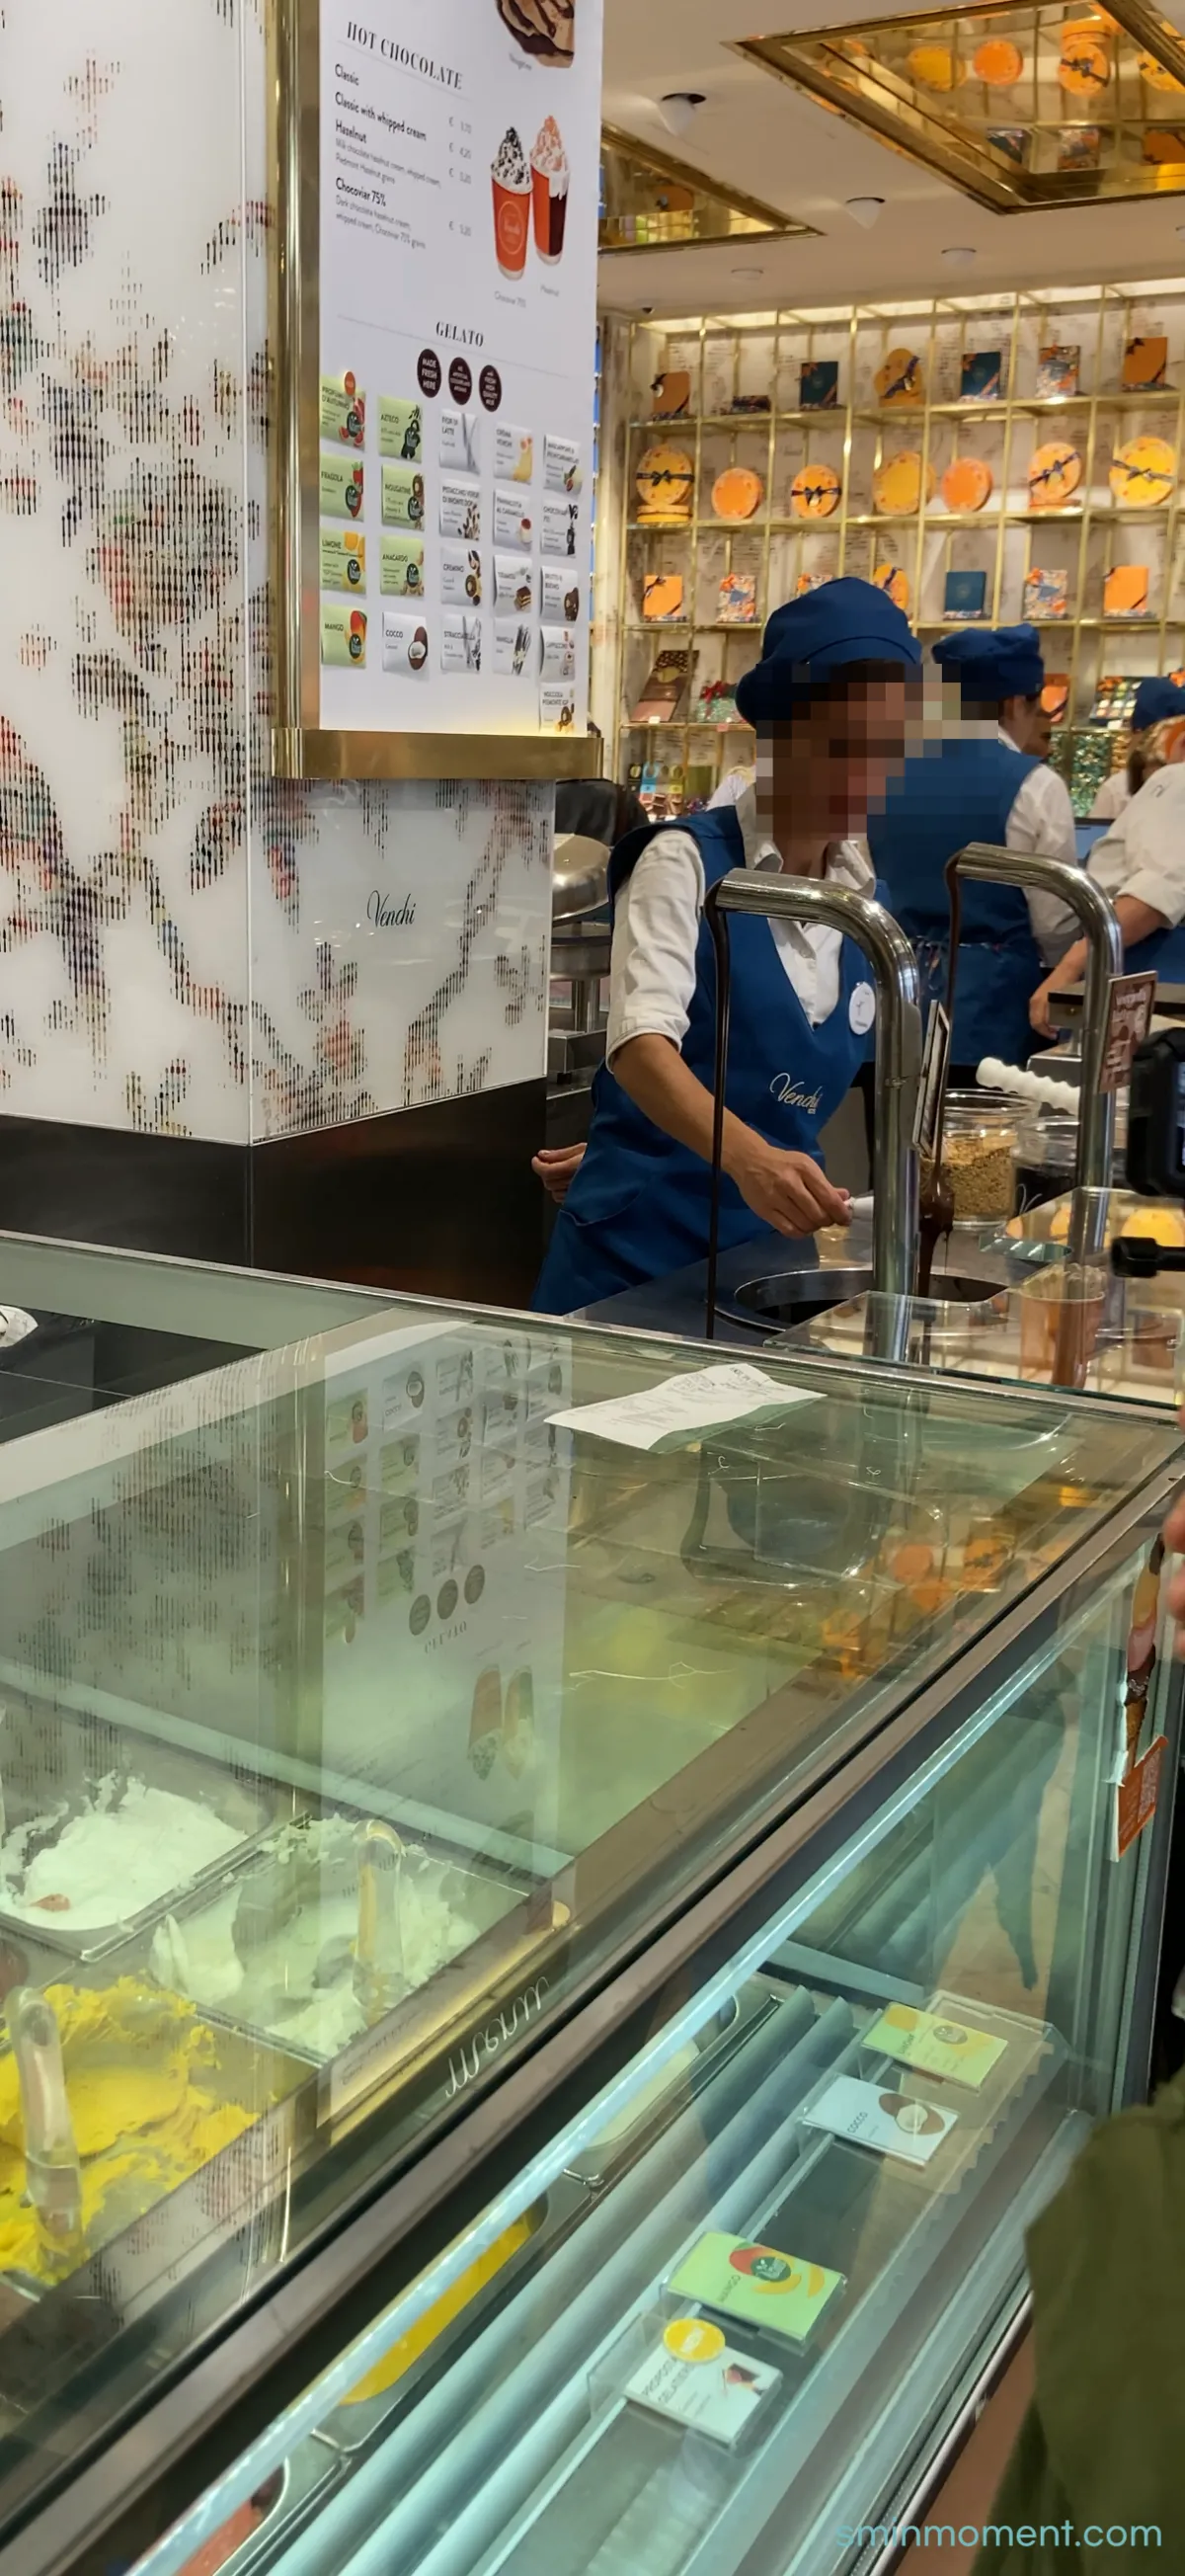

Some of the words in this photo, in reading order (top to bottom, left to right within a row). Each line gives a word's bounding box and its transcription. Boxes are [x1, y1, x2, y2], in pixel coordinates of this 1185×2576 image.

[348, 21, 377, 49] HOT
[380, 38, 463, 90] CHOCOLATE
[335, 63, 359, 86] Classic
[335, 91, 359, 114] Classic
[360, 104, 376, 120] with
[377, 112, 405, 133] whipped
[406, 126, 427, 141] cream
[336, 119, 367, 144] Hazelnut
[336, 177, 370, 201] Chocoviar
[371, 189, 386, 207] 75%
[435, 321, 484, 347] GELATO
[422, 358, 436, 368] MADE
[422, 367, 437, 379] FRESH
[423, 380, 436, 390] HERE
[321, 471, 344, 483] FRAGOLA
[322, 539, 342, 550] LIMONE
[382, 554, 408, 563] ANACARDO
[442, 563, 464, 573] CREMINO
[324, 623, 344, 632] MANGO
[385, 629, 404, 639] COCCO
[366, 890, 417, 928] Venchi
[770, 1073, 823, 1108] Venchi
[846, 2112, 868, 2133] COCCO
